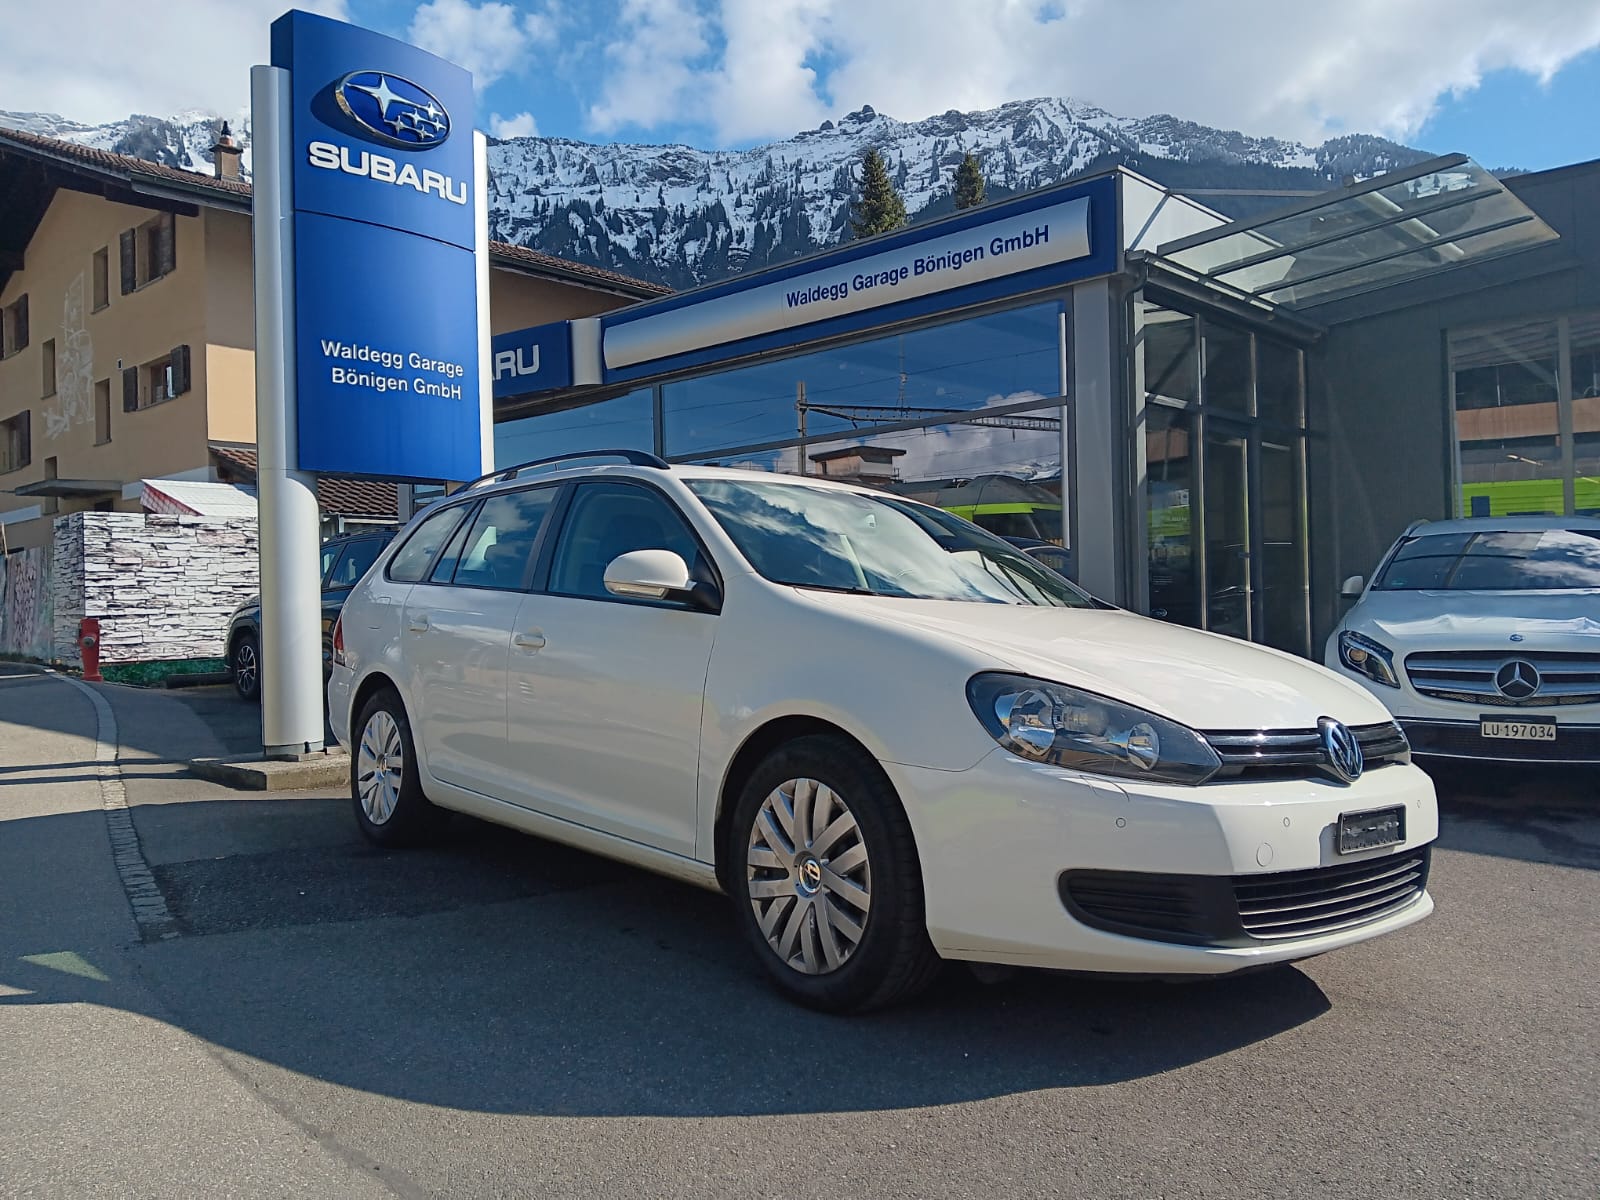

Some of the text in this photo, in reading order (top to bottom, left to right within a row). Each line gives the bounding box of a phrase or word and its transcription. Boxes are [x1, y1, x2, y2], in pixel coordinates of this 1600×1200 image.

[309, 141, 467, 205] SUBARU
[786, 224, 1049, 308] Waldegg Garage Bönigen GmbH
[320, 339, 464, 378] Waldegg Garage
[492, 344, 540, 381] RU
[331, 367, 462, 400] Bönigen GmbH
